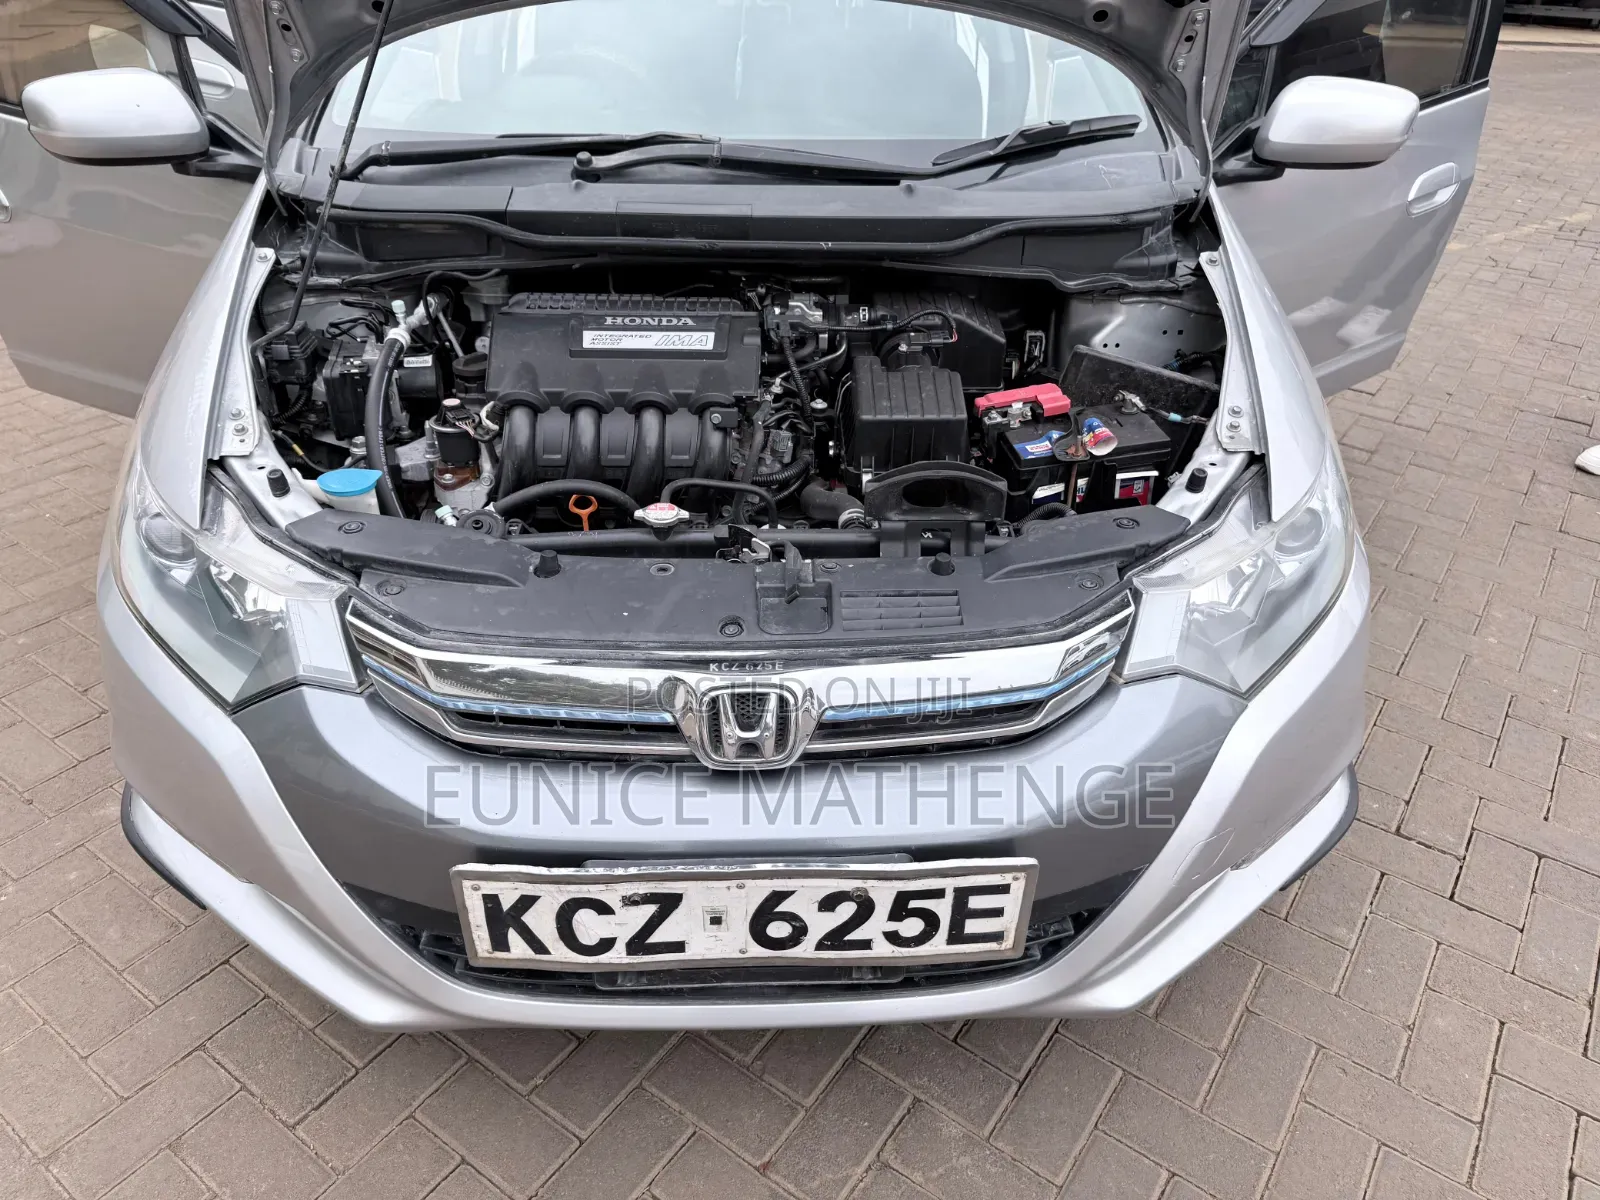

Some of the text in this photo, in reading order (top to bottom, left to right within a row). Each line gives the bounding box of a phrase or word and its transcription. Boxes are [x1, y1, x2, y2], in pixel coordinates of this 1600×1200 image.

[604, 316, 697, 326] HONDA
[655, 334, 709, 347] IMA
[709, 661, 784, 672] KCZ 625E
[481, 883, 1011, 957] KCZ 625E
